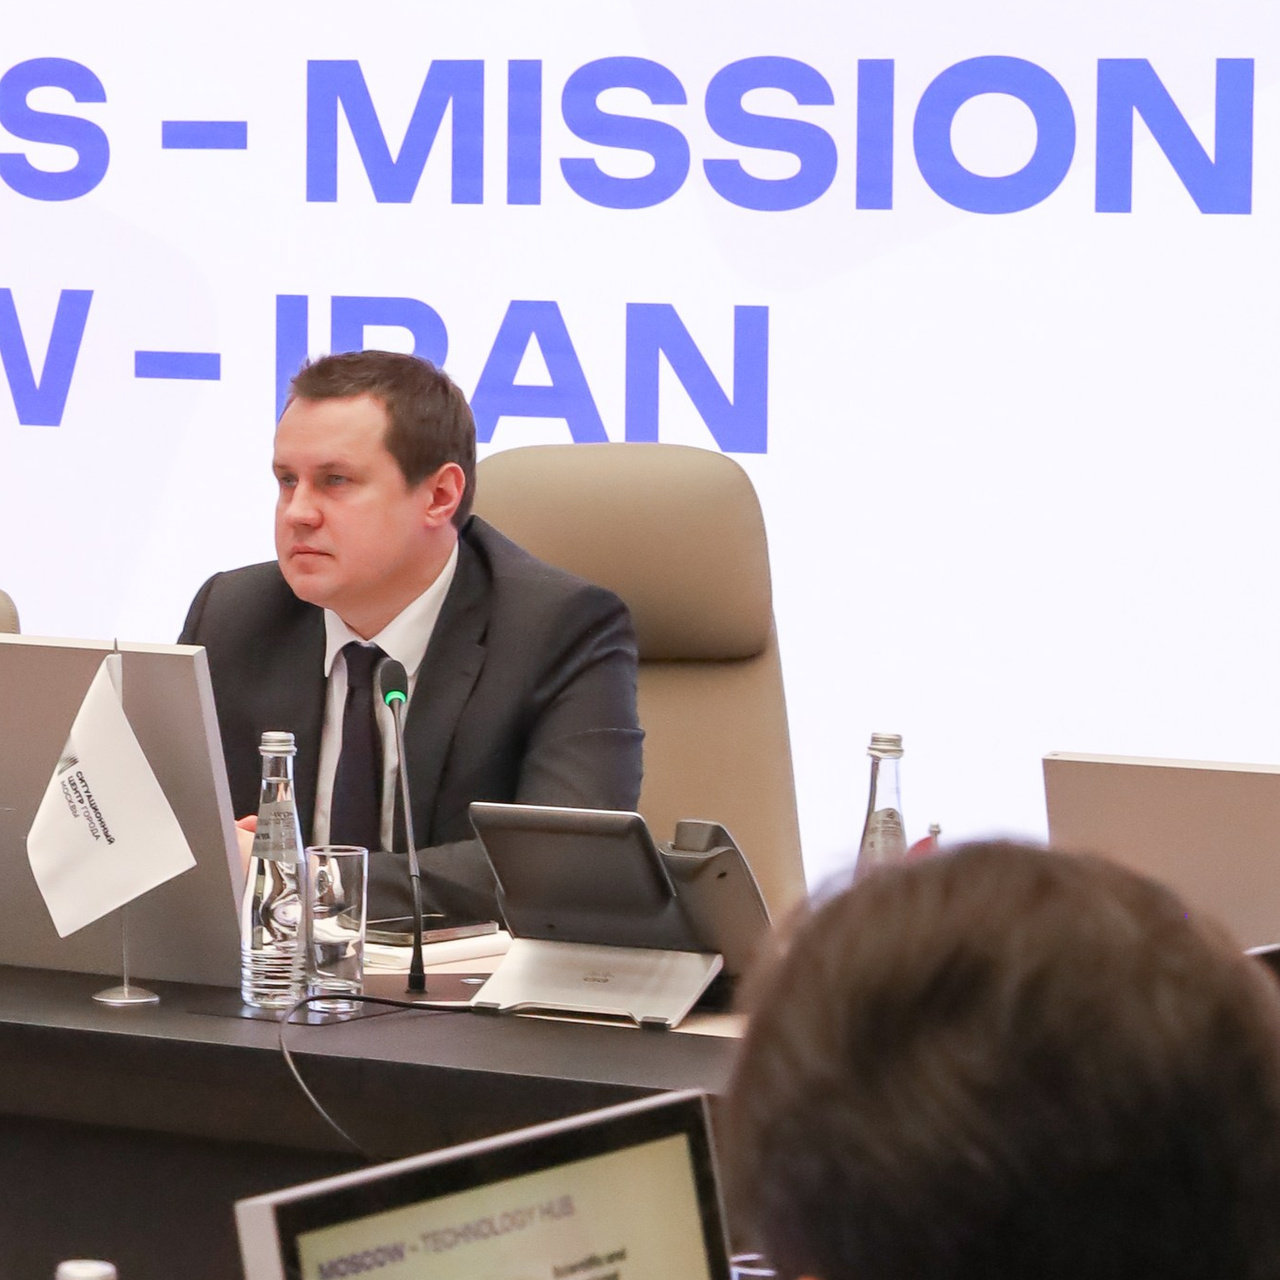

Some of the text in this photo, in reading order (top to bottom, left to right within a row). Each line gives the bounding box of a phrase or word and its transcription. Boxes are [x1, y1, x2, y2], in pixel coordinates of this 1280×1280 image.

[305, 54, 1255, 216] MISSION
[60, 780, 80, 818] МОСКВЫ
[67, 775, 101, 841] ЦЕНТР ГОРОДА
[76, 770, 116, 846] СИТУАЦИОННЫЙ
